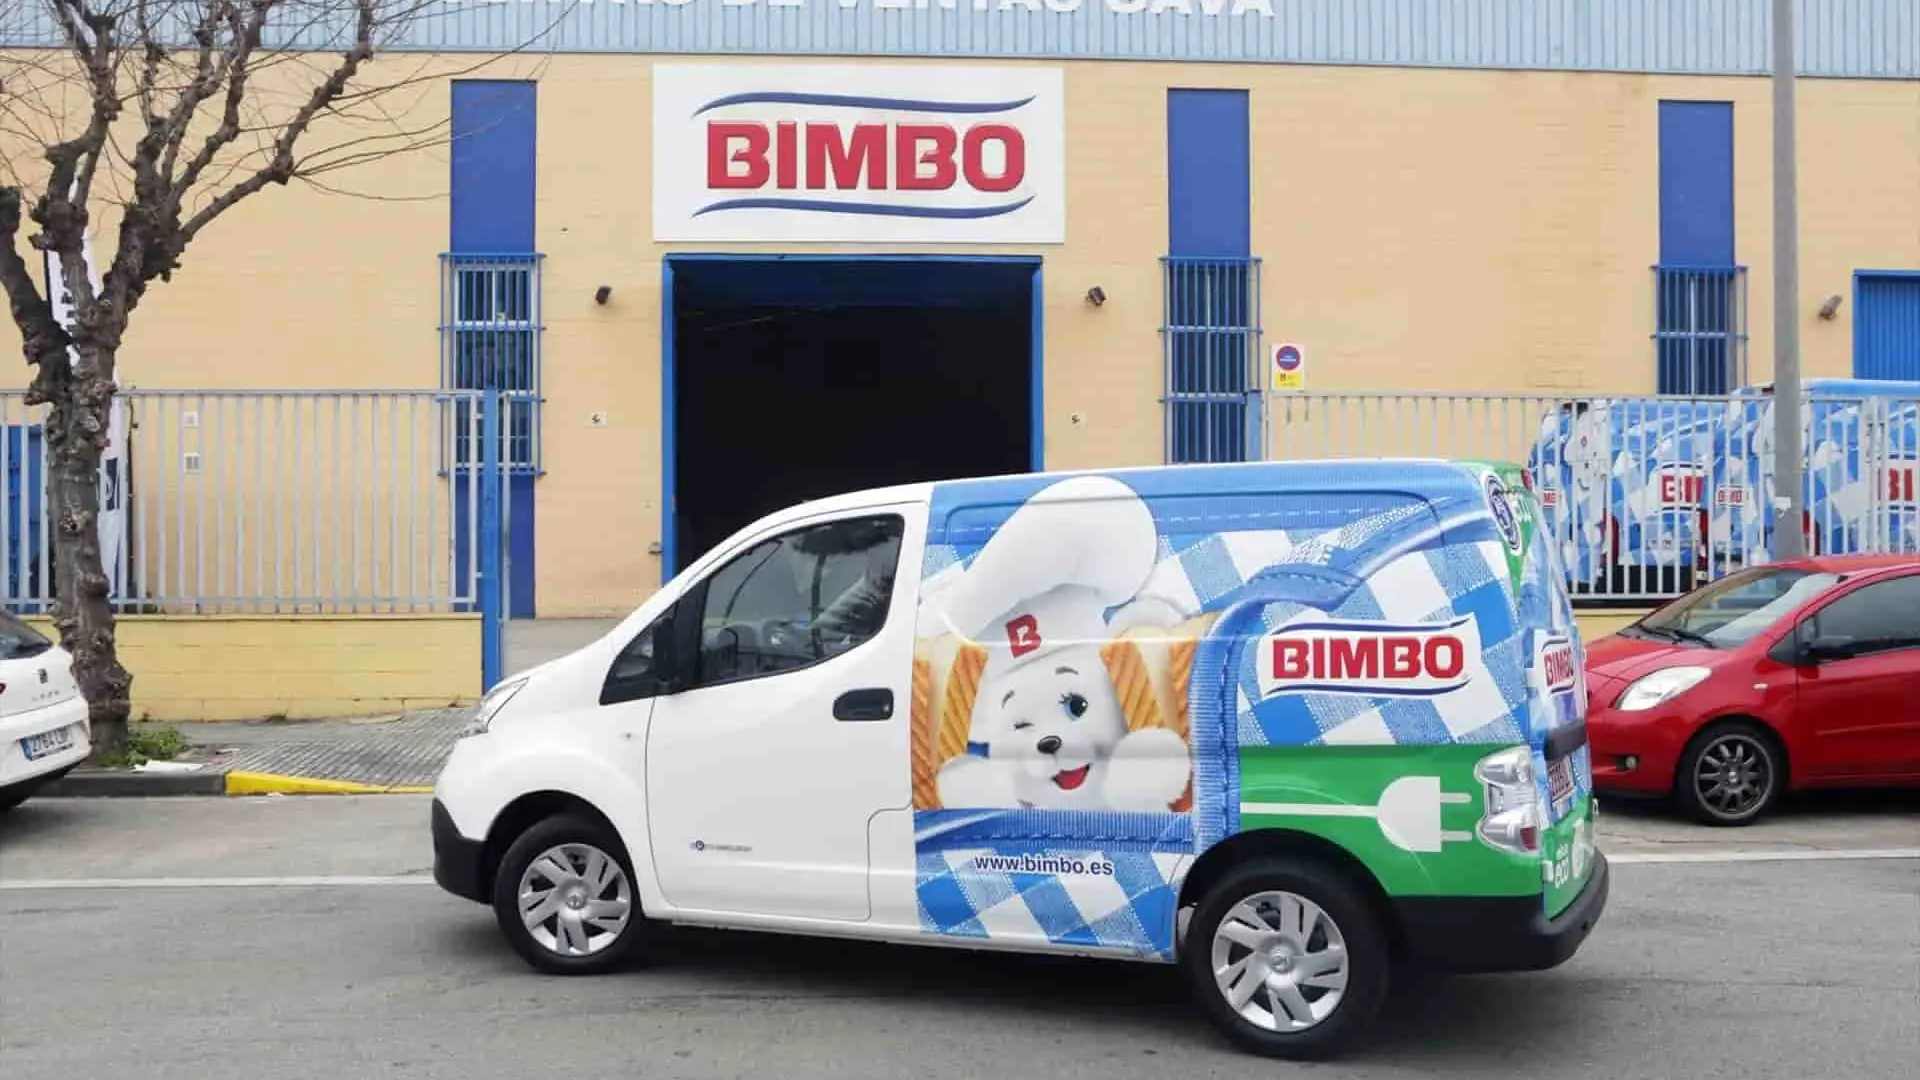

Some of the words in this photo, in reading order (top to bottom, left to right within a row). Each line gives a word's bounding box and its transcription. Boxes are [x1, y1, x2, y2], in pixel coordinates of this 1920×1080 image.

[706, 120, 1026, 192] BIMBO
[1273, 636, 1464, 680] BIMBO
[975, 854, 1114, 876] www.bimbo.es
